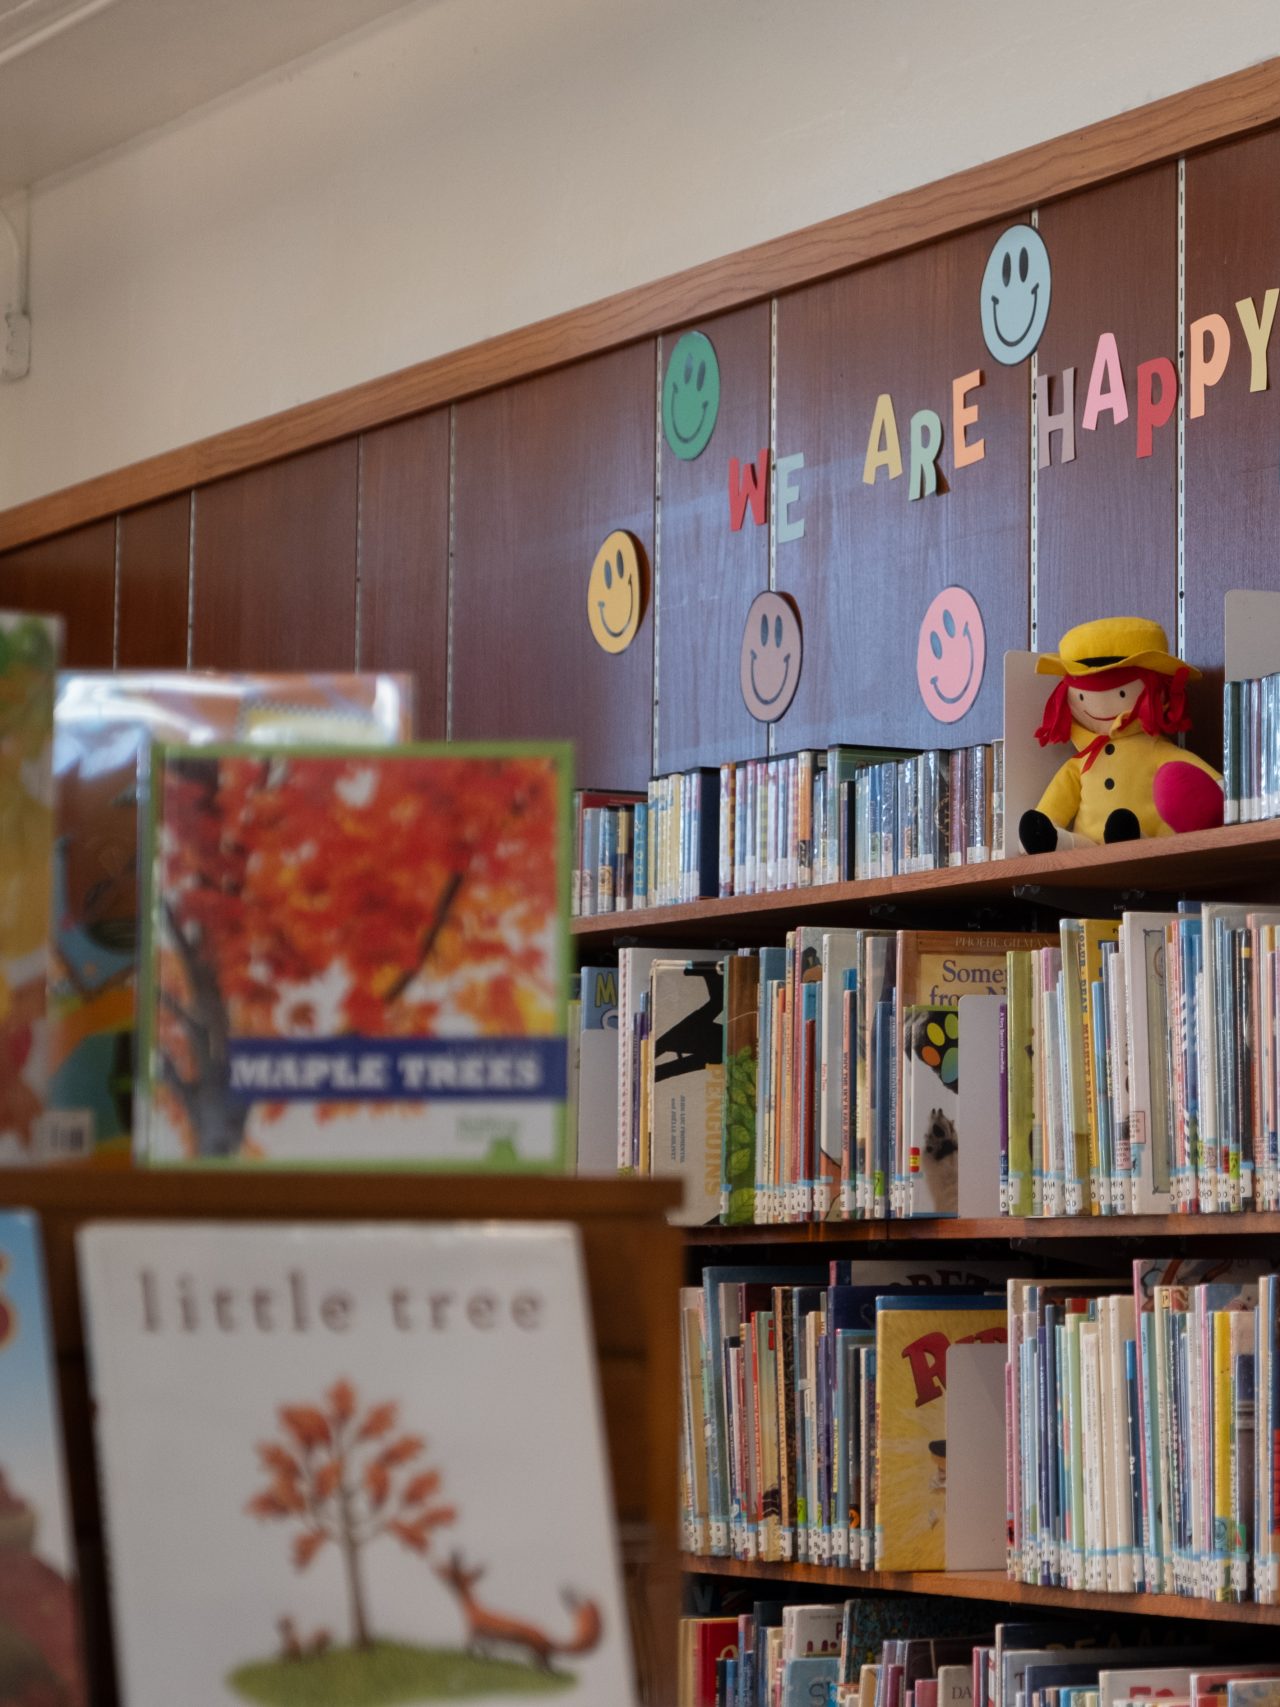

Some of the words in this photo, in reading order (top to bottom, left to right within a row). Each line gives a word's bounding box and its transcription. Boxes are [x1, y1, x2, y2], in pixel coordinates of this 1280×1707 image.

[728, 448, 804, 543] WE
[863, 369, 985, 501] ARE
[1037, 288, 1280, 468] HAPPY
[955, 936, 1000, 948] PHOEBE
[229, 1054, 386, 1089] MAPLE
[399, 1054, 542, 1090] TREES
[704, 1062, 724, 1197] PENGUINS
[139, 1269, 353, 1335] little
[390, 1285, 545, 1335] tree
